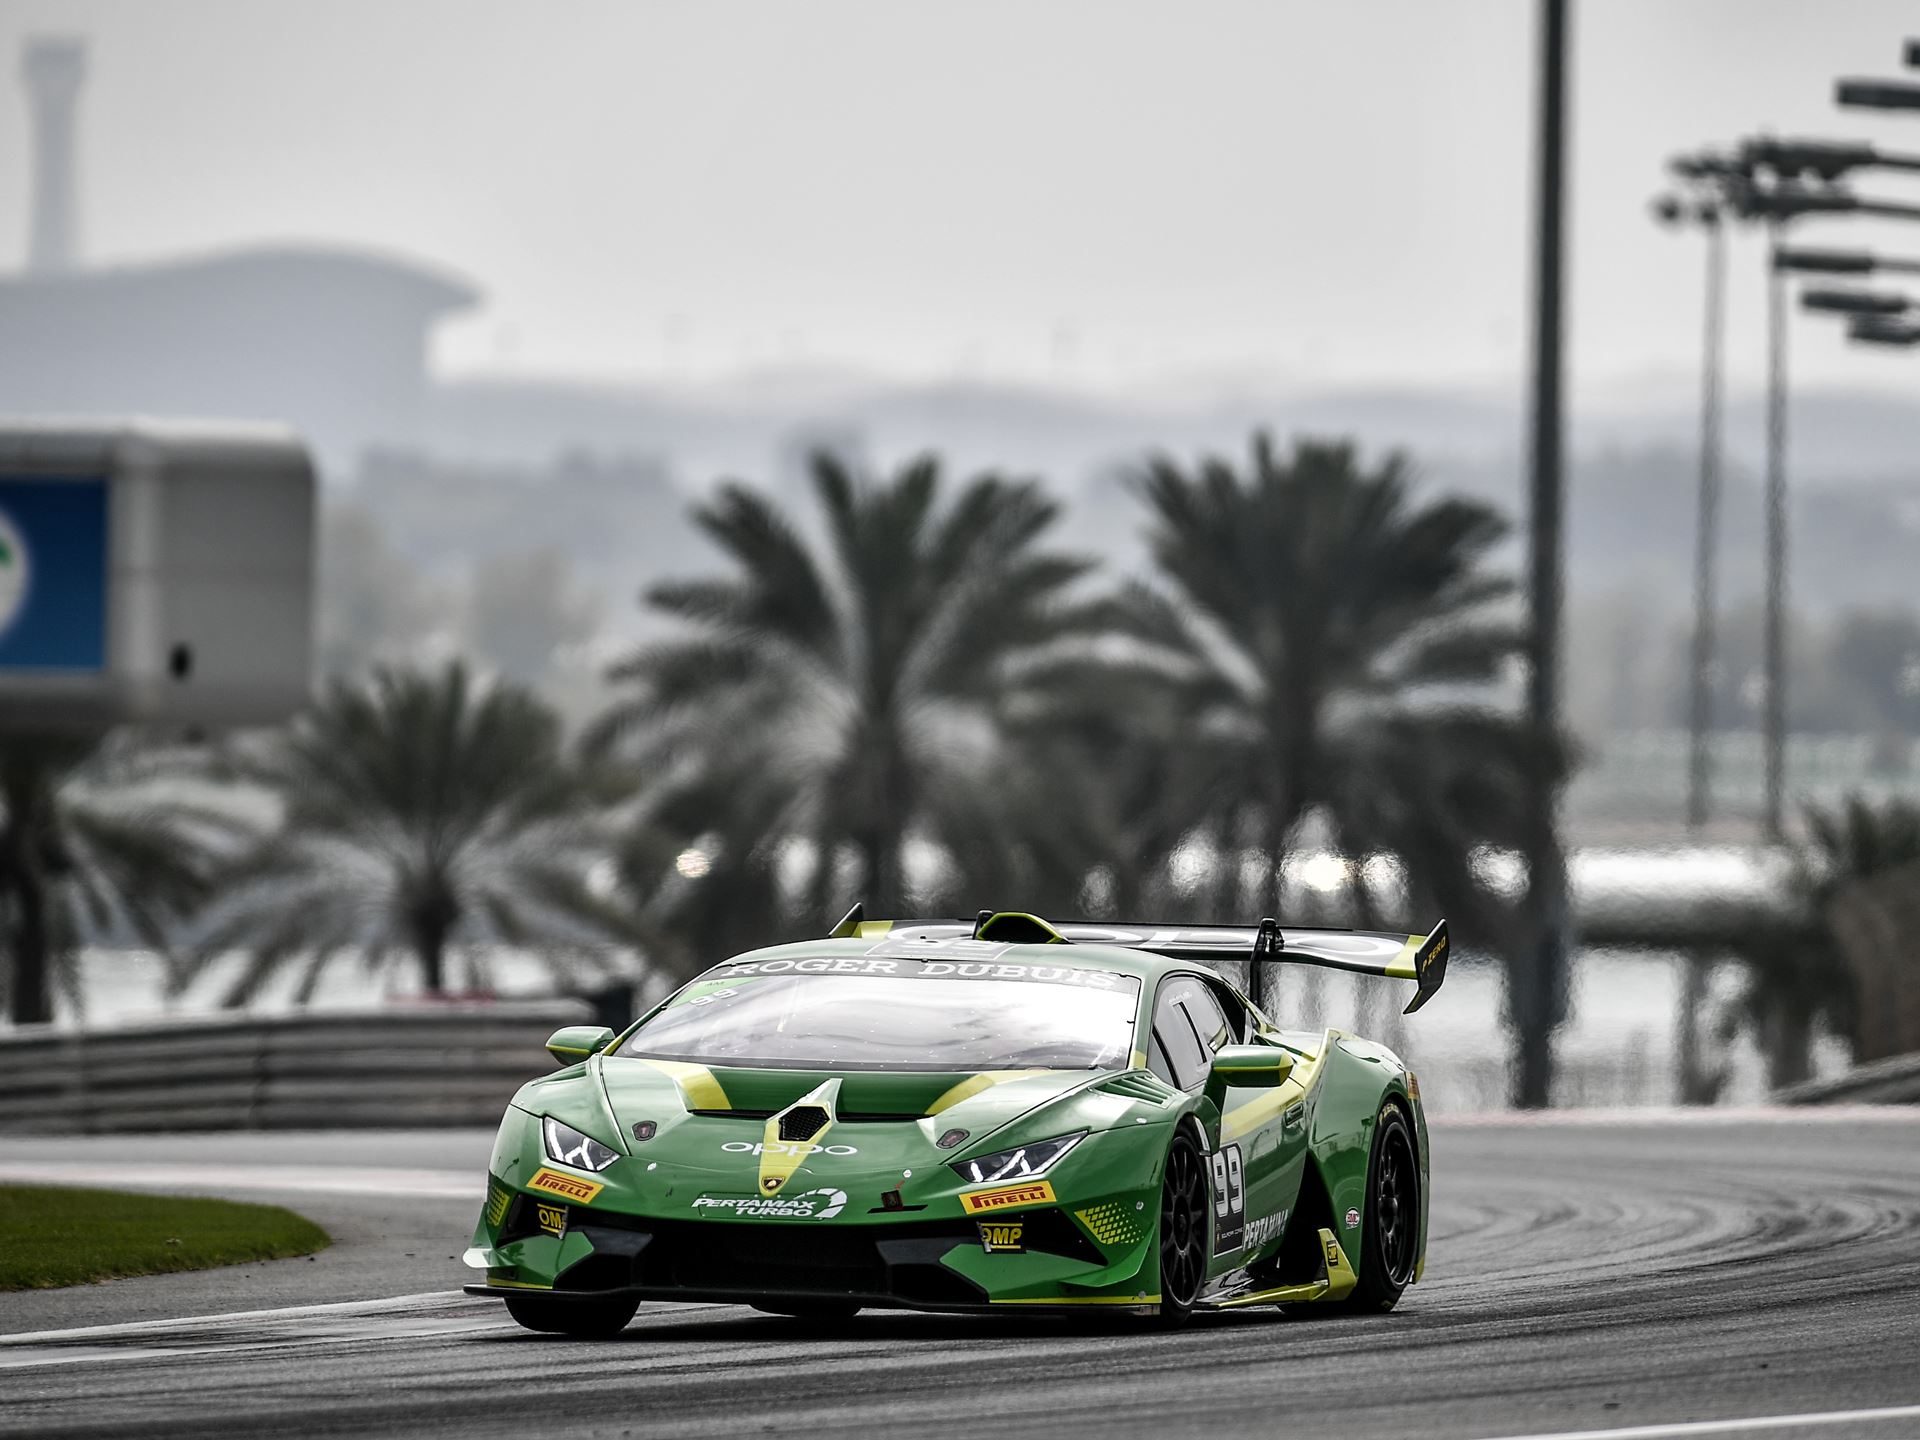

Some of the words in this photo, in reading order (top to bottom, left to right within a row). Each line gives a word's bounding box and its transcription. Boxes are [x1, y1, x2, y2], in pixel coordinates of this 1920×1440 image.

[720, 958, 899, 978] ROGER
[917, 961, 1118, 988] DUBUIS
[690, 988, 739, 1007] 99
[721, 1141, 858, 1157] oppo
[535, 1173, 595, 1199] PIRELLI
[1211, 1146, 1243, 1218] 99
[691, 1198, 818, 1208] PERTAMAX
[969, 1185, 1047, 1209] PIRELLI
[538, 1209, 565, 1229] OM
[735, 1206, 814, 1217] TURBO
